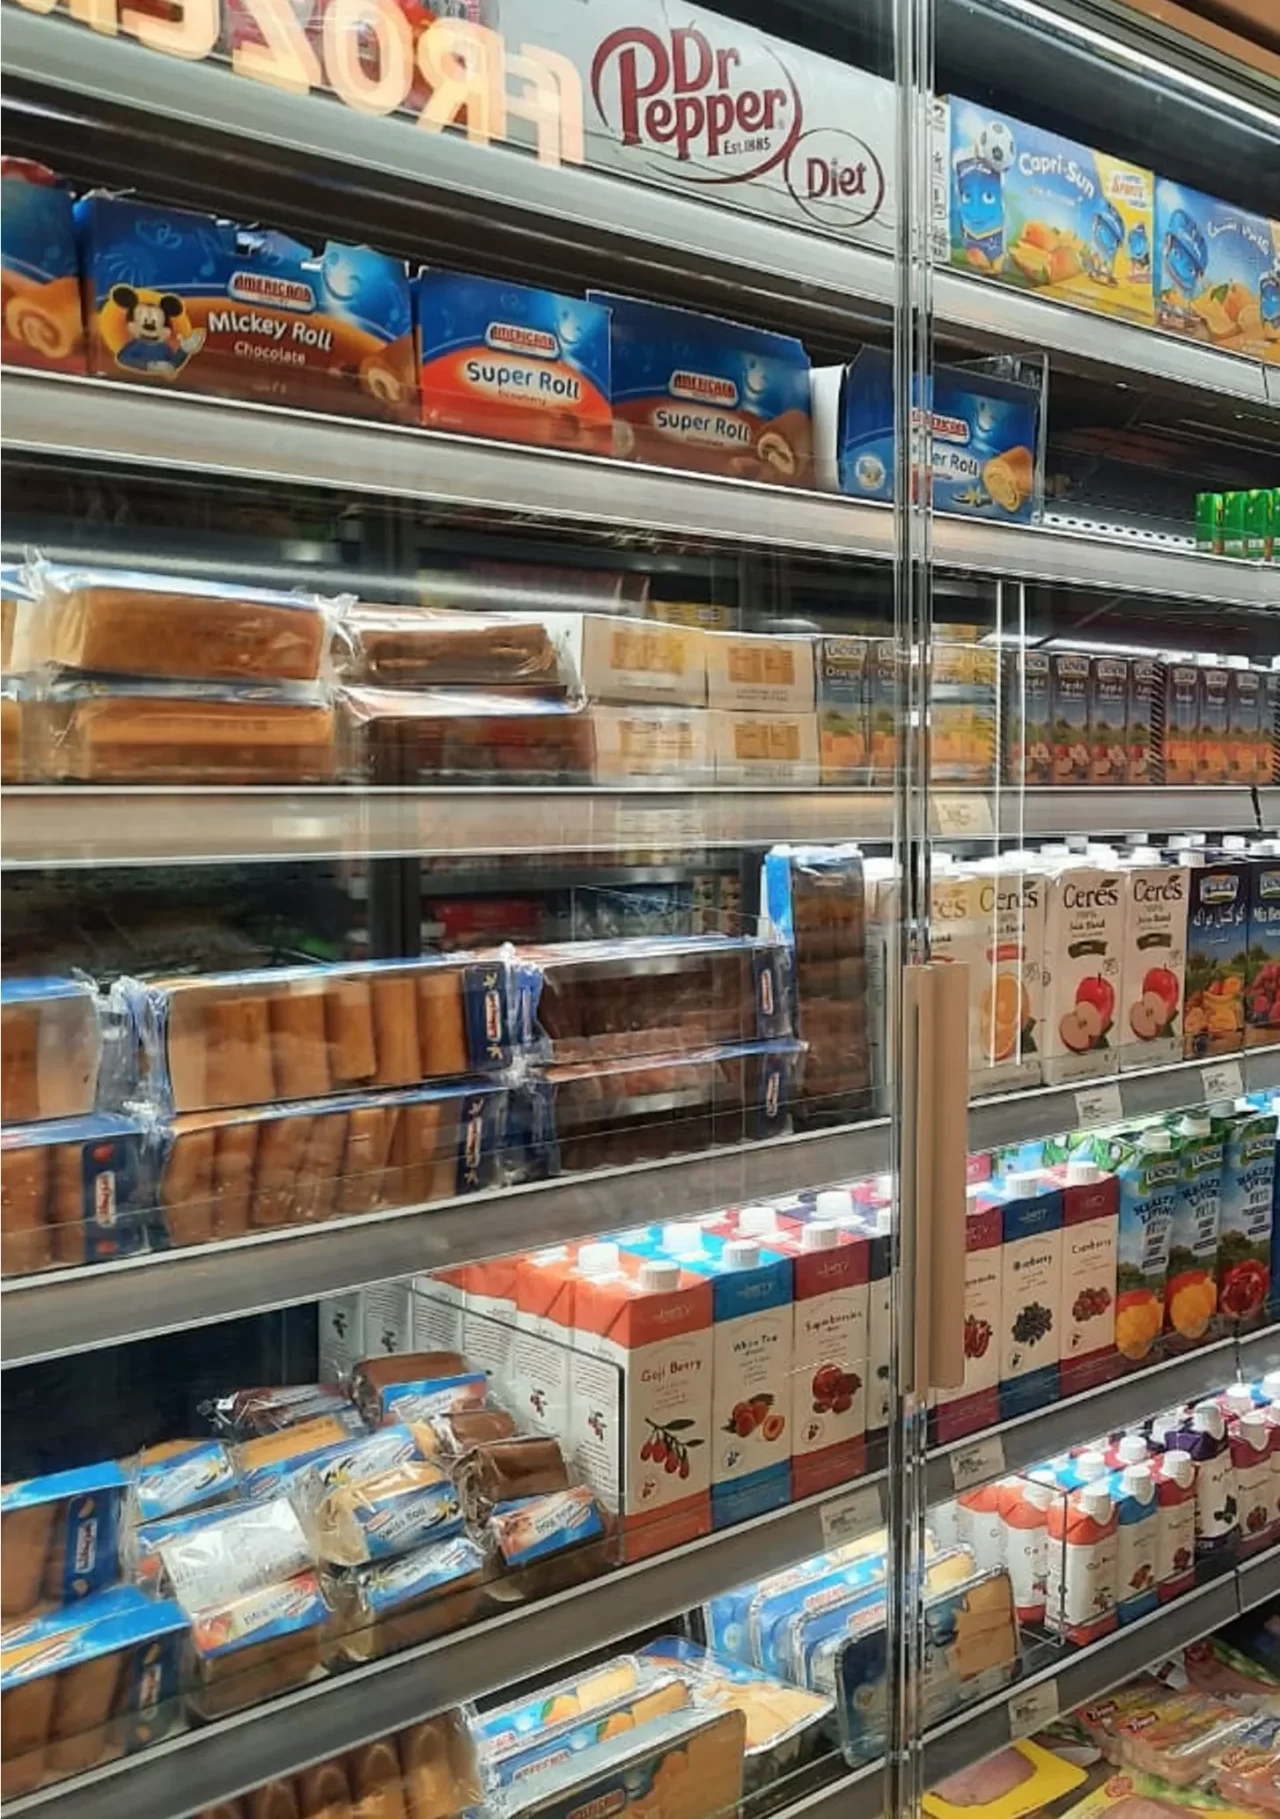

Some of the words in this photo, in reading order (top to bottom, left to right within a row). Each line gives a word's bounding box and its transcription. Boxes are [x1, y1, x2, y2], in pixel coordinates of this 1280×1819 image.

[670, 26, 740, 93] Dr
[591, 27, 787, 161] Pepper
[807, 157, 867, 199] Diet
[1019, 152, 1095, 198] Capri-Sun
[208, 311, 286, 339] Mickey
[292, 321, 332, 351] Roll
[234, 341, 305, 364] Chocolate
[466, 361, 533, 386] Super
[539, 371, 580, 400] Roll
[656, 410, 710, 431] Super
[716, 417, 748, 441] Roll
[950, 455, 978, 476] Roll
[980, 886, 1038, 912] Ceres
[1064, 884, 1119, 909] Ceres
[1134, 879, 1183, 902] Ceres
[640, 1365, 667, 1384] Goji
[670, 1358, 702, 1375] Berry
